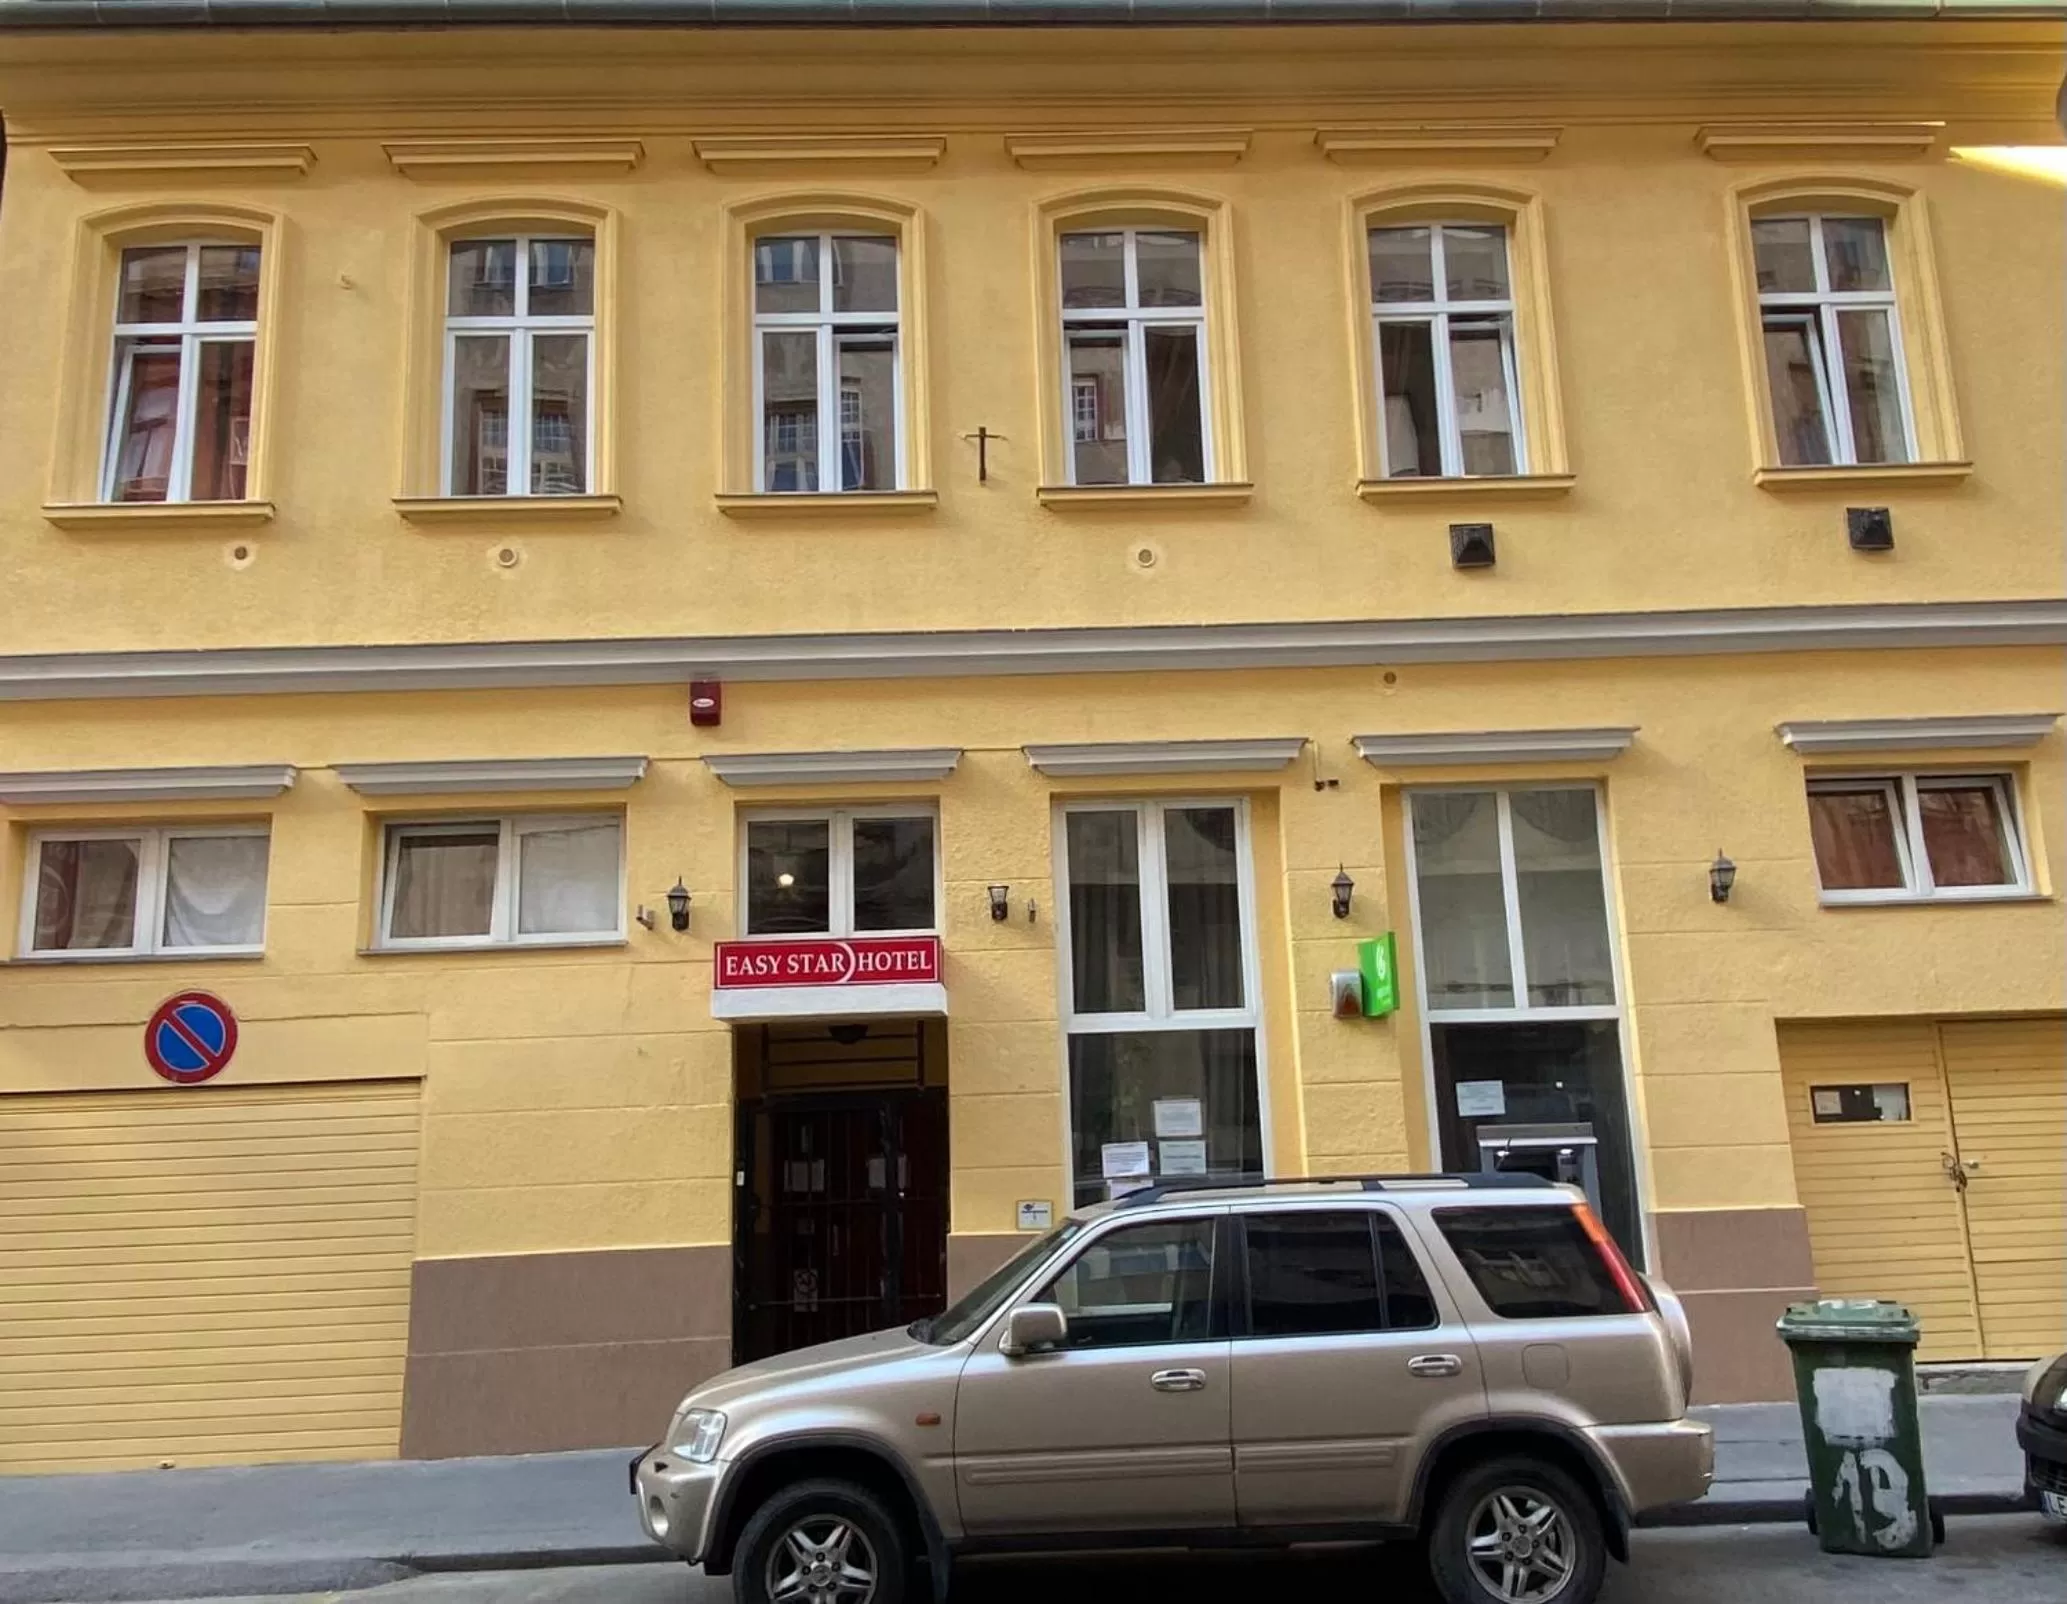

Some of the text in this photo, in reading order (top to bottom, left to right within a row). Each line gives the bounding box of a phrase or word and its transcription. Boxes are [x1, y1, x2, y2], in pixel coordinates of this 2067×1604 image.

[725, 950, 932, 976] EASY STAR HOTEL
